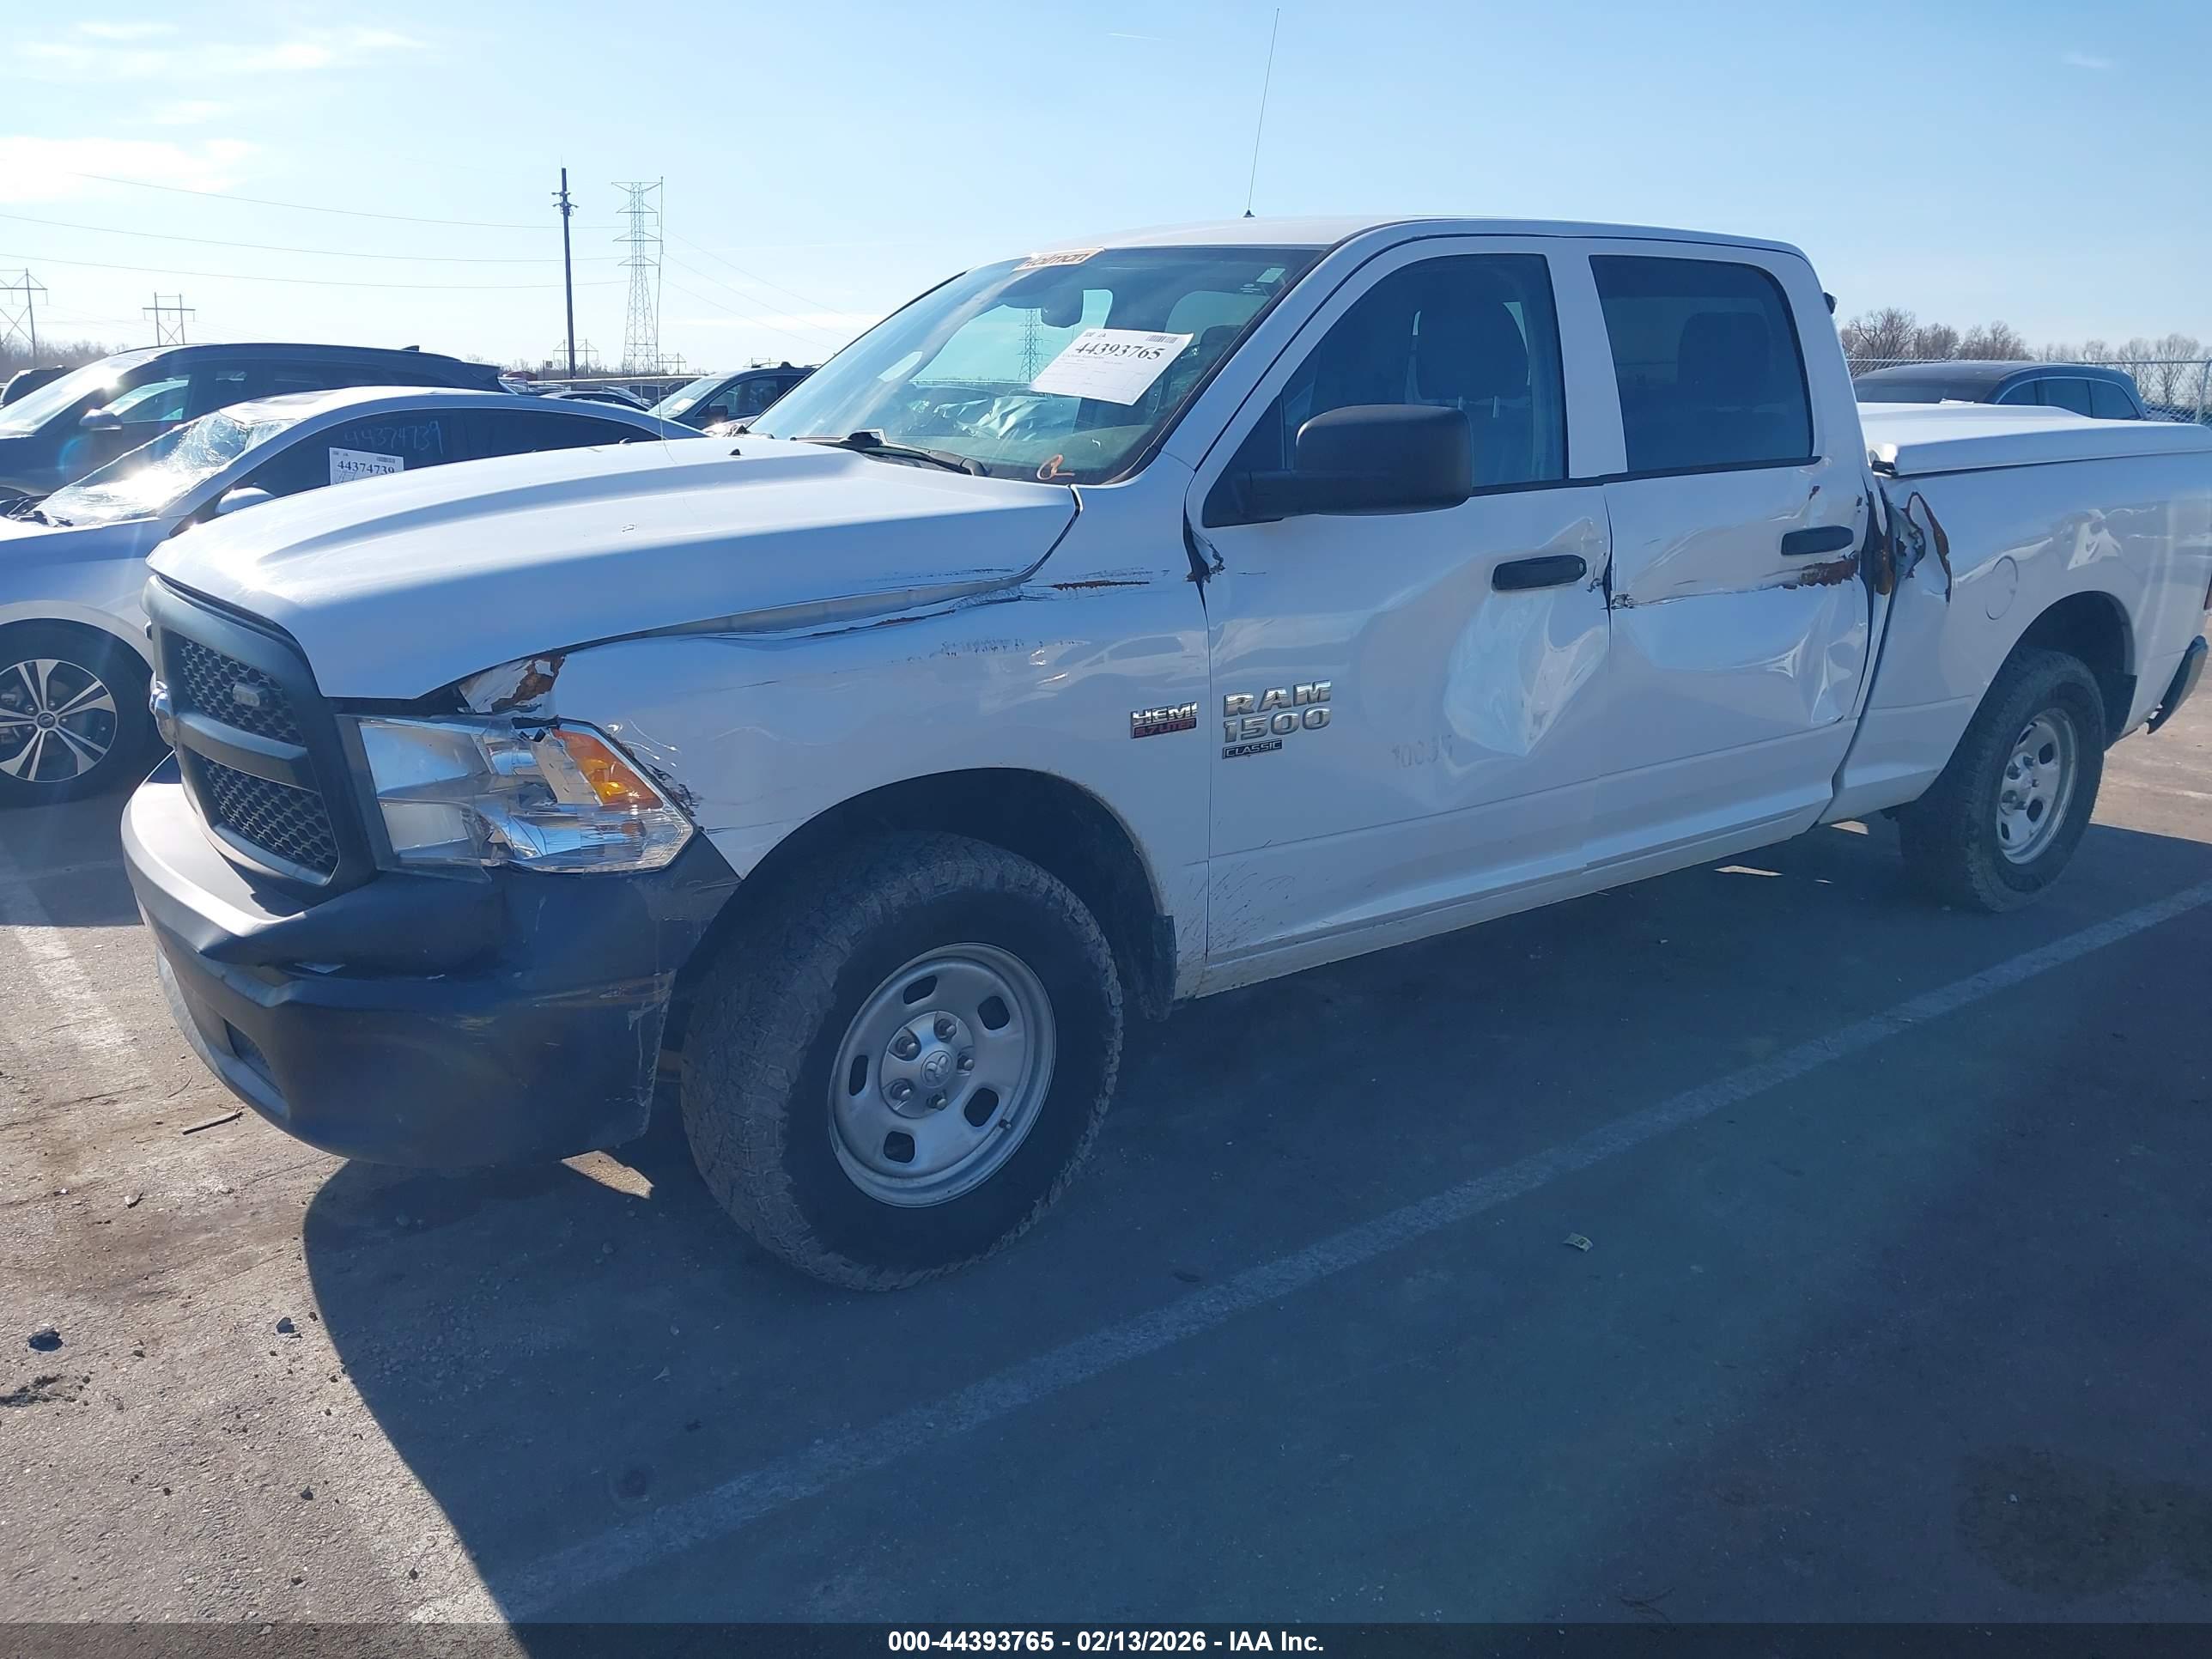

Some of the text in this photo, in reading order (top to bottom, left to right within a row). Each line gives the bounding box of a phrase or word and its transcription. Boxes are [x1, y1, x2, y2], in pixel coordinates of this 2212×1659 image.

[1075, 342, 1166, 361] 44393765
[343, 420, 444, 454] 44374739
[1224, 679, 1332, 718] RAM
[1131, 702, 1199, 726] HEMI
[1223, 705, 1332, 744] 1500
[1224, 740, 1282, 757] CLASSIC
